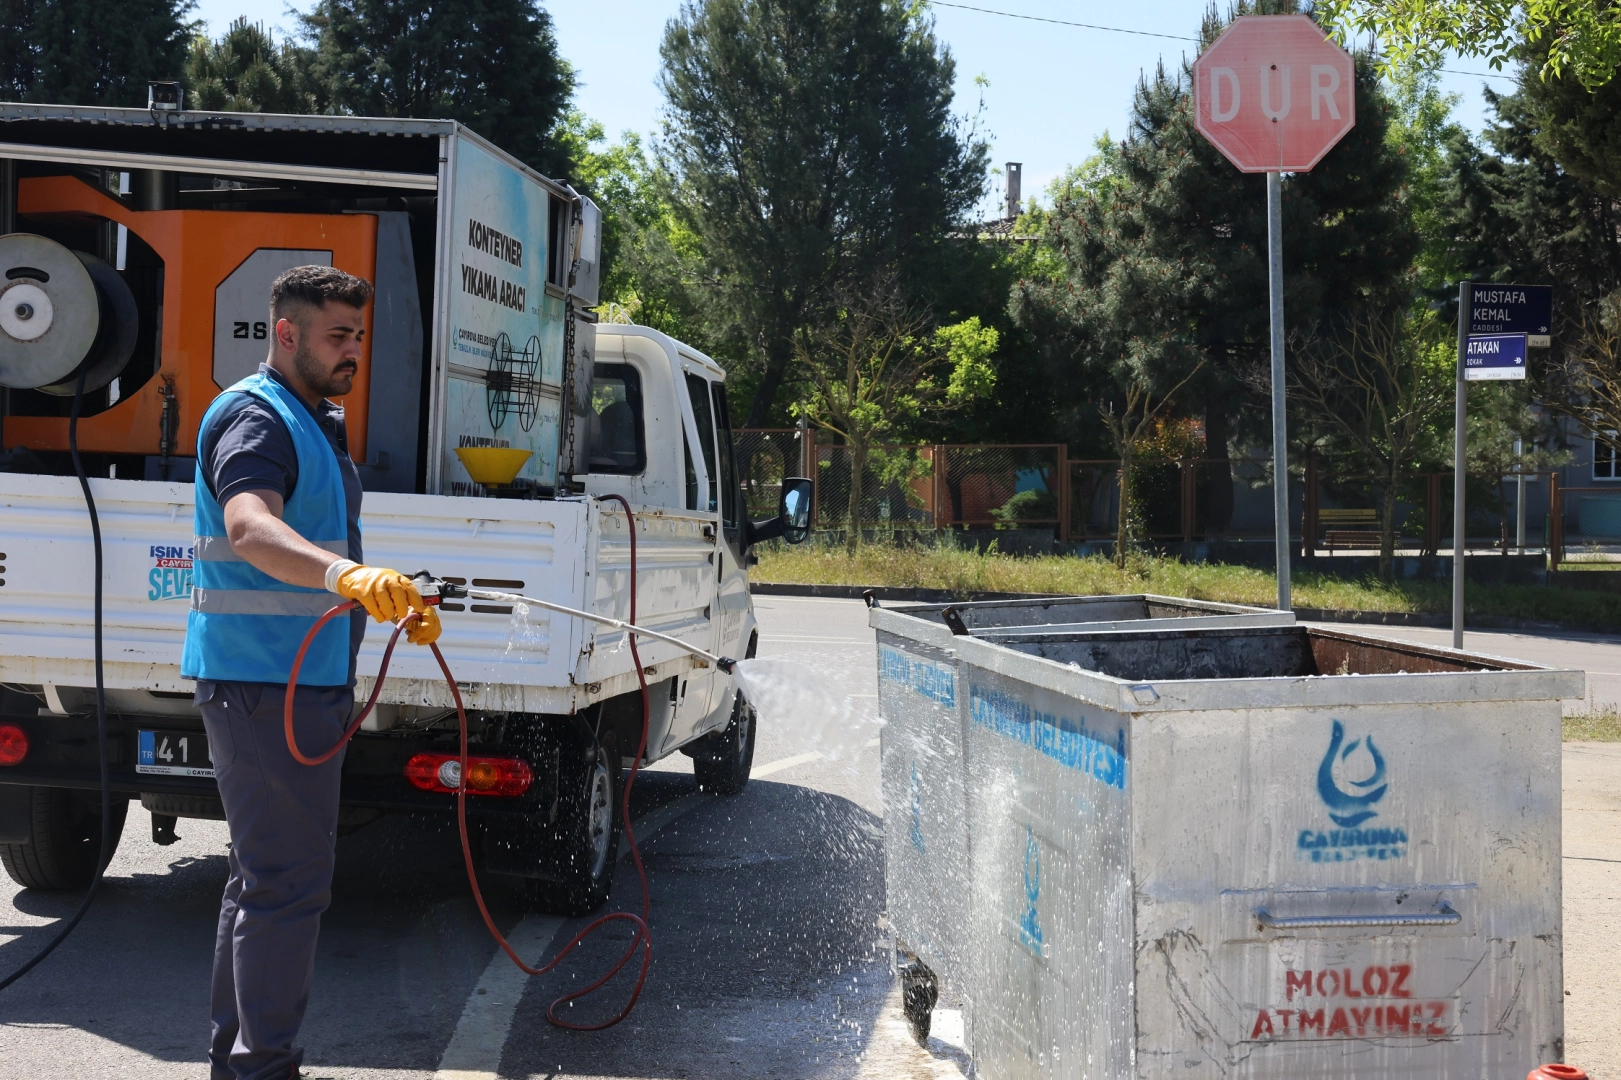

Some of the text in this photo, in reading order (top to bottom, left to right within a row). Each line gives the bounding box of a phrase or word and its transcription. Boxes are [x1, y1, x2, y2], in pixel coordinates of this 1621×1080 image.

[1210, 64, 1342, 122] DUR
[468, 218, 523, 268] KONTEYNER
[461, 263, 526, 313] YIKAMA ARACI
[1474, 290, 1527, 304] MUSTAFA
[1473, 308, 1512, 321] KEMAL
[1472, 324, 1503, 332] CADDESİ
[1467, 340, 1500, 355] ATAKAN
[1466, 358, 1483, 366] SOKAK
[142, 750, 153, 759] TR
[158, 736, 190, 763] 41
[1286, 964, 1412, 1002] MOLOZ
